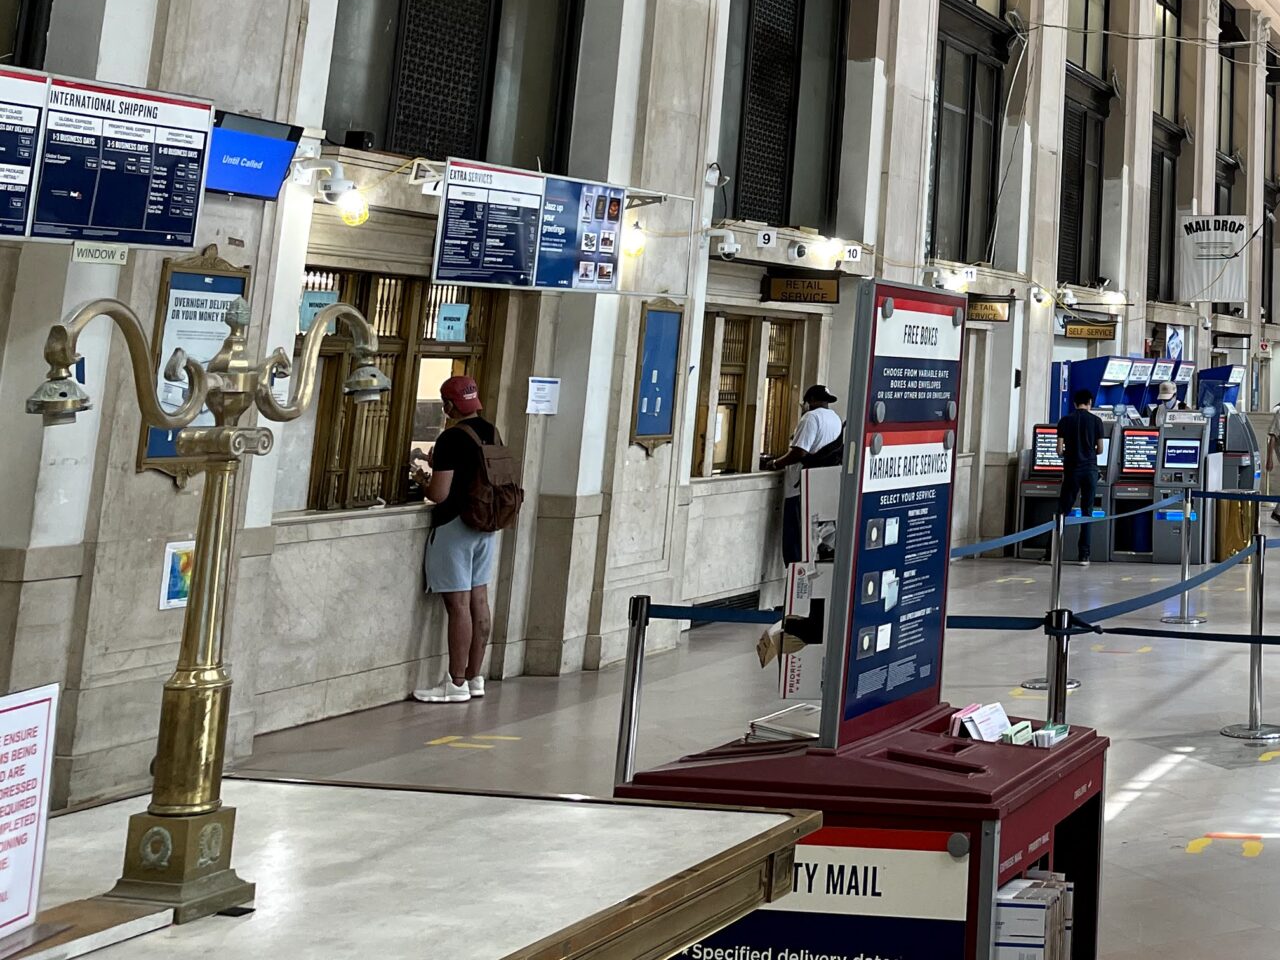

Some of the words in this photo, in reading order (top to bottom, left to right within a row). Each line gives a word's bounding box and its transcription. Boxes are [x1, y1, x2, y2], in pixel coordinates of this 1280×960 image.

[50, 90, 116, 113] INTERNATIONAL
[118, 101, 159, 119] SHIPPING
[222, 154, 239, 166] Until
[240, 157, 264, 170] Called
[450, 169, 467, 181] EXTRA
[468, 171, 493, 184] SERVICES
[1183, 219, 1211, 236] MAIL
[1213, 219, 1245, 234] DROP
[762, 233, 771, 245] 9
[76, 248, 117, 260] WINDOW
[119, 250, 126, 261] 6
[847, 248, 857, 259] 10
[964, 270, 973, 279] 11
[785, 279, 823, 290] RETAIL
[174, 296, 208, 309] OVERNIGHT
[209, 299, 231, 311] DELIVE
[780, 291, 828, 302] SERVICE
[171, 309, 180, 320] OR
[181, 310, 197, 320] YOUR
[198, 311, 219, 322] MONEY
[903, 324, 920, 345] FREE
[920, 326, 938, 346] BOXES
[1068, 327, 1084, 336] SELF
[1087, 327, 1113, 337] SERVICE
[883, 367, 903, 377] CHOOSE
[904, 368, 917, 377] FROM
[918, 369, 938, 378] VARIABLE
[938, 370, 949, 378] RATE
[890, 379, 906, 388] BOXES
[907, 380, 917, 388] AND
[918, 380, 941, 389] ENVELOPES
[894, 391, 903, 399] ANY
[904, 391, 917, 399] OTHER
[869, 456, 902, 481] VARIABLE
[902, 455, 920, 477] RATE
[920, 452, 948, 476] SERVICES
[880, 494, 900, 505] SELECT
[901, 492, 915, 503] YOUR
[789, 655, 797, 693] PRIORITY
[3, 726, 39, 746] ENSURE
[11, 743, 37, 761] BEING
[8, 764, 26, 780] ARE
[0, 778, 38, 799] DRESSED
[0, 795, 37, 817] EQUIRED
[826, 864, 883, 897] MAIL
[692, 943, 772, 960] Specified
